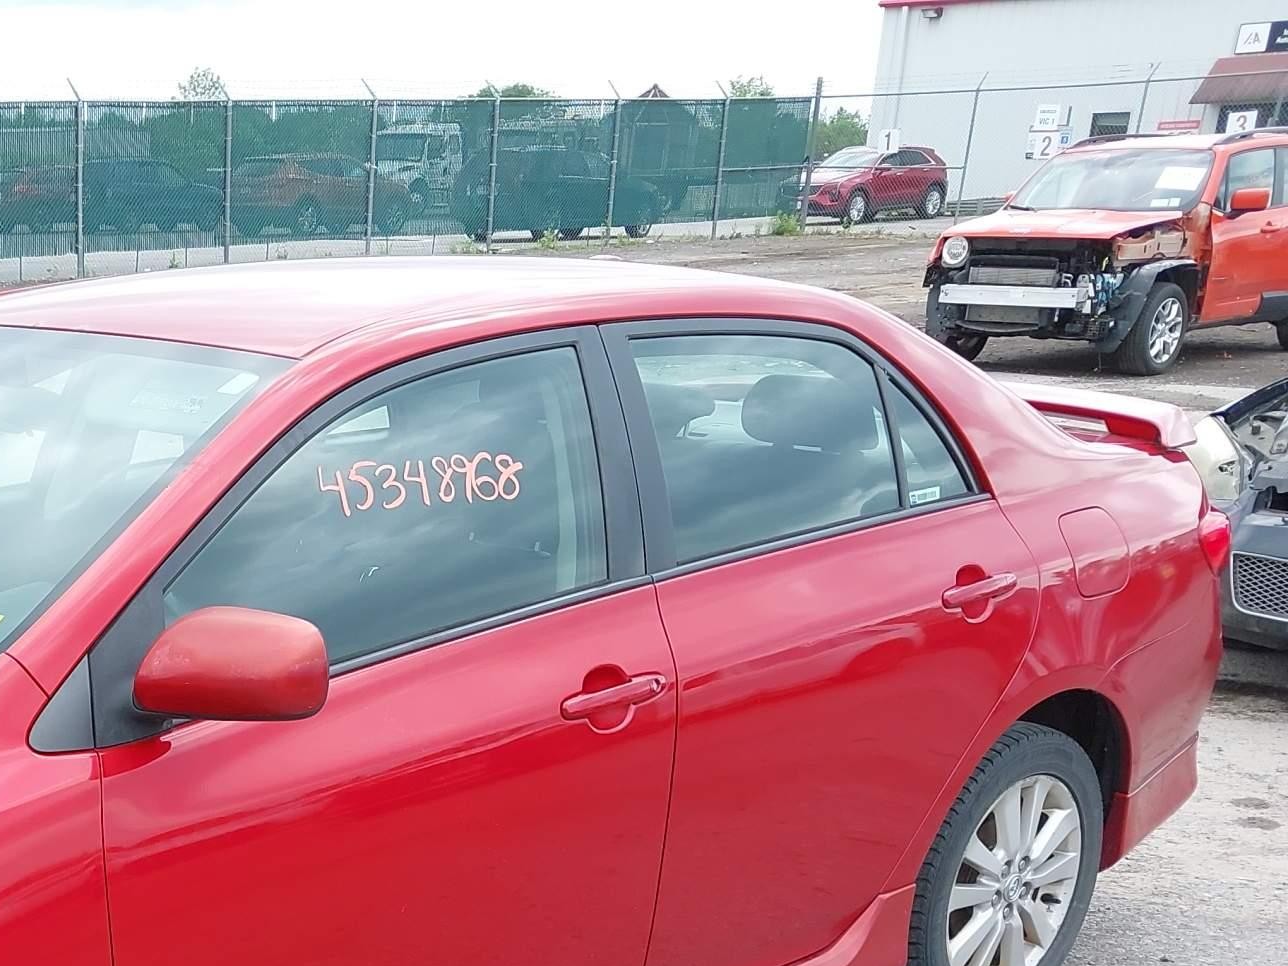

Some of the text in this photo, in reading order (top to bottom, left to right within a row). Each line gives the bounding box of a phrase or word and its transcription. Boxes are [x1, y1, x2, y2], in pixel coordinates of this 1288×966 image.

[884, 131, 891, 151] 1
[1039, 135, 1052, 157] 2
[317, 451, 523, 517] 45348968
